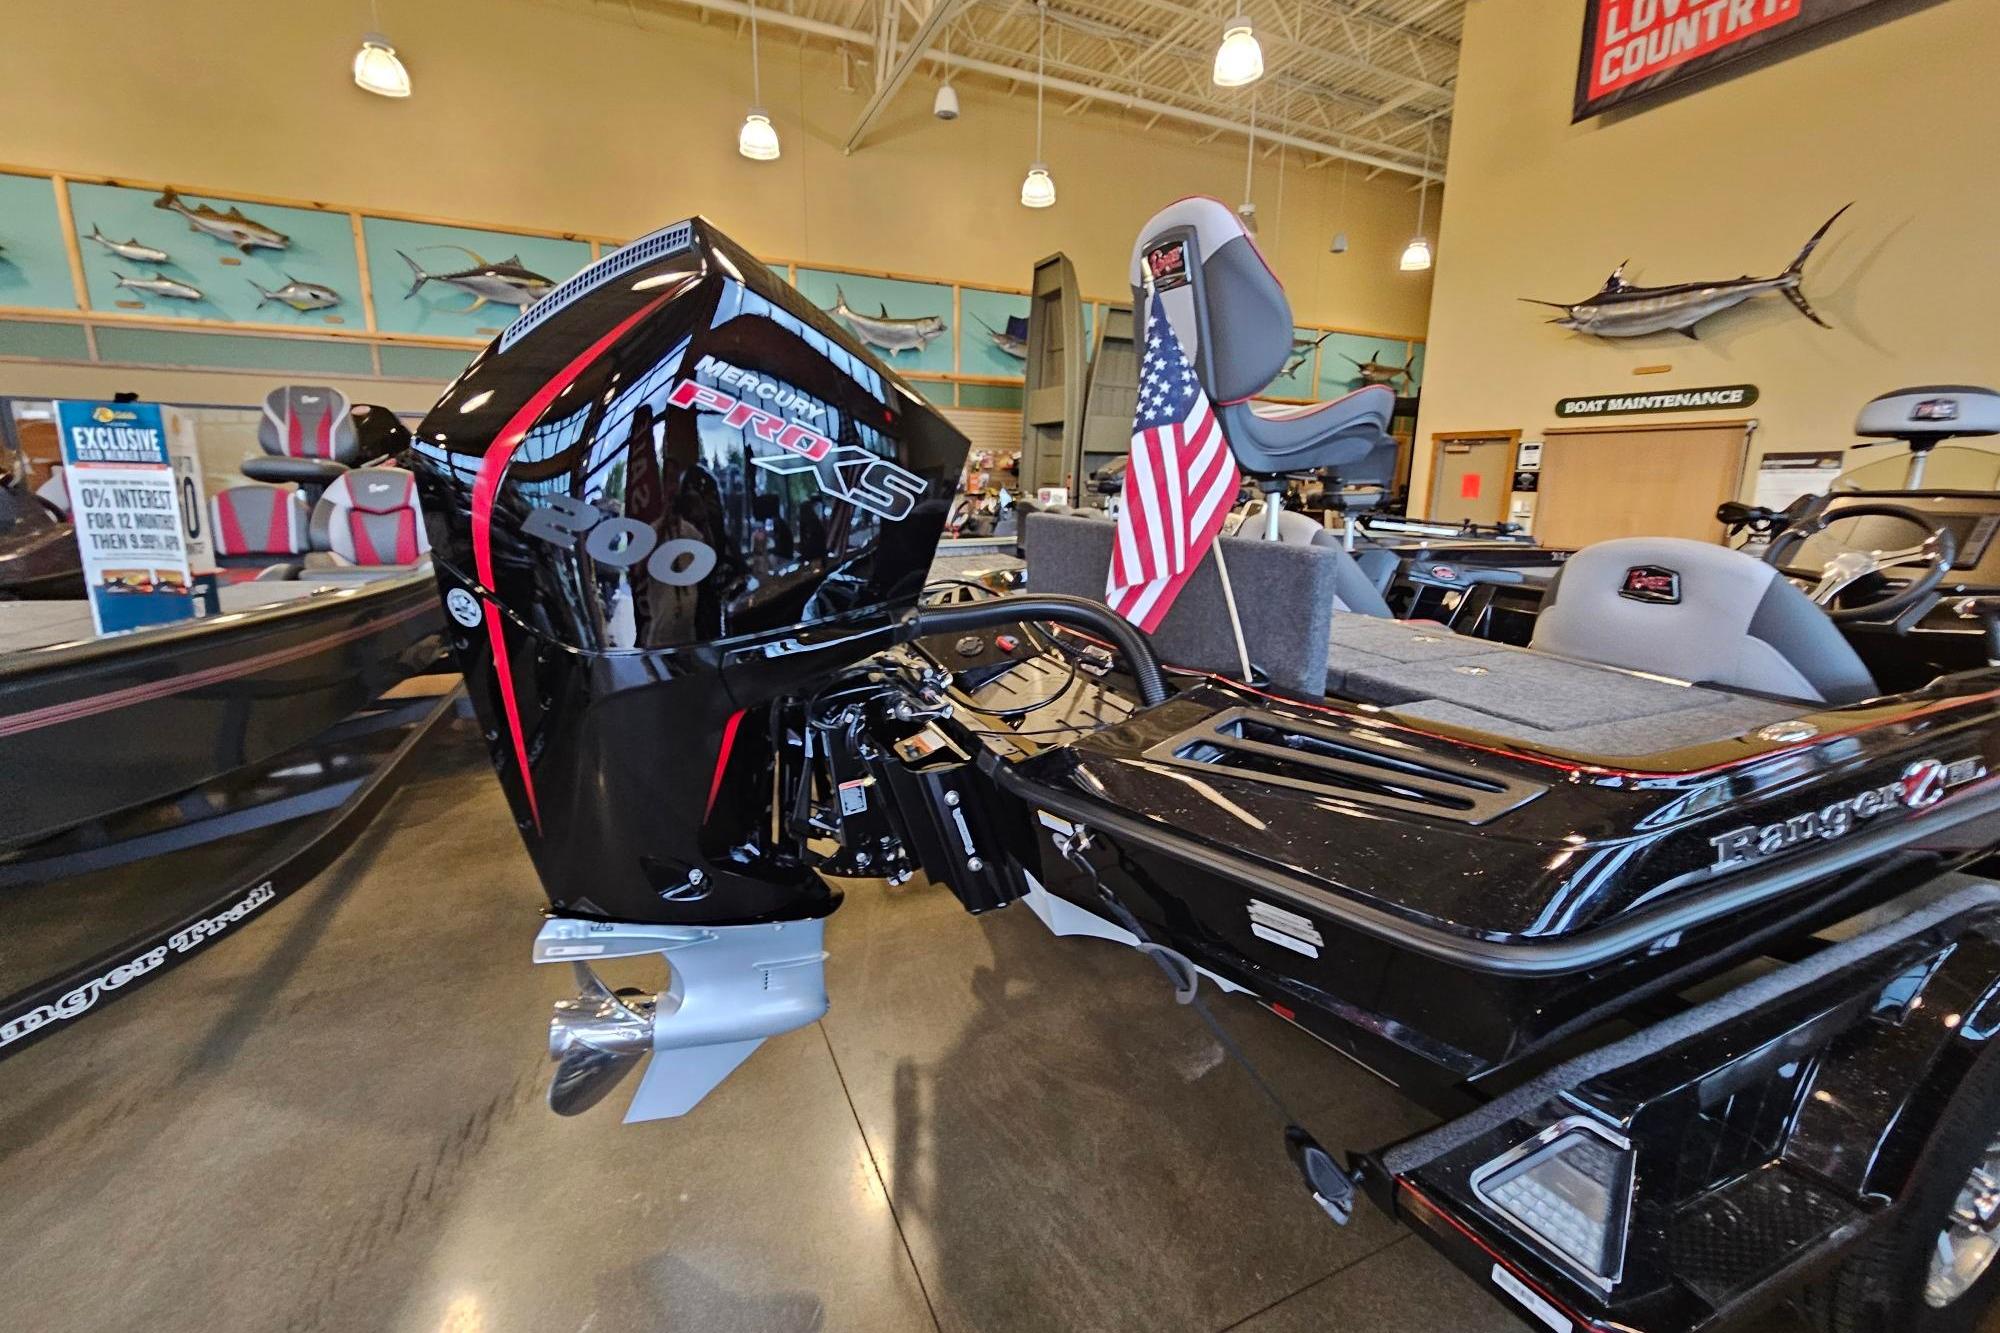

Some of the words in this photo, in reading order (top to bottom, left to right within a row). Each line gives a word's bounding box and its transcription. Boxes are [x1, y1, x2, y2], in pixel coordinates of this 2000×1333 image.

[1604, 0, 1703, 46] LOV
[694, 354, 826, 420] MERCURY
[1564, 399, 1607, 414] BOAT
[1607, 389, 1745, 411] MAINTENANCE
[71, 427, 161, 451] EXCLUSIVE
[667, 378, 833, 462] PRO
[750, 444, 929, 522] XS
[82, 488, 111, 509] 0%
[113, 489, 173, 511] INTEREST
[86, 512, 115, 529] FOR
[117, 512, 132, 529] 12
[89, 533, 128, 549] THEN
[519, 492, 718, 587] 200
[1709, 782, 1905, 871] Ranger
[0, 947, 168, 1048] nger
